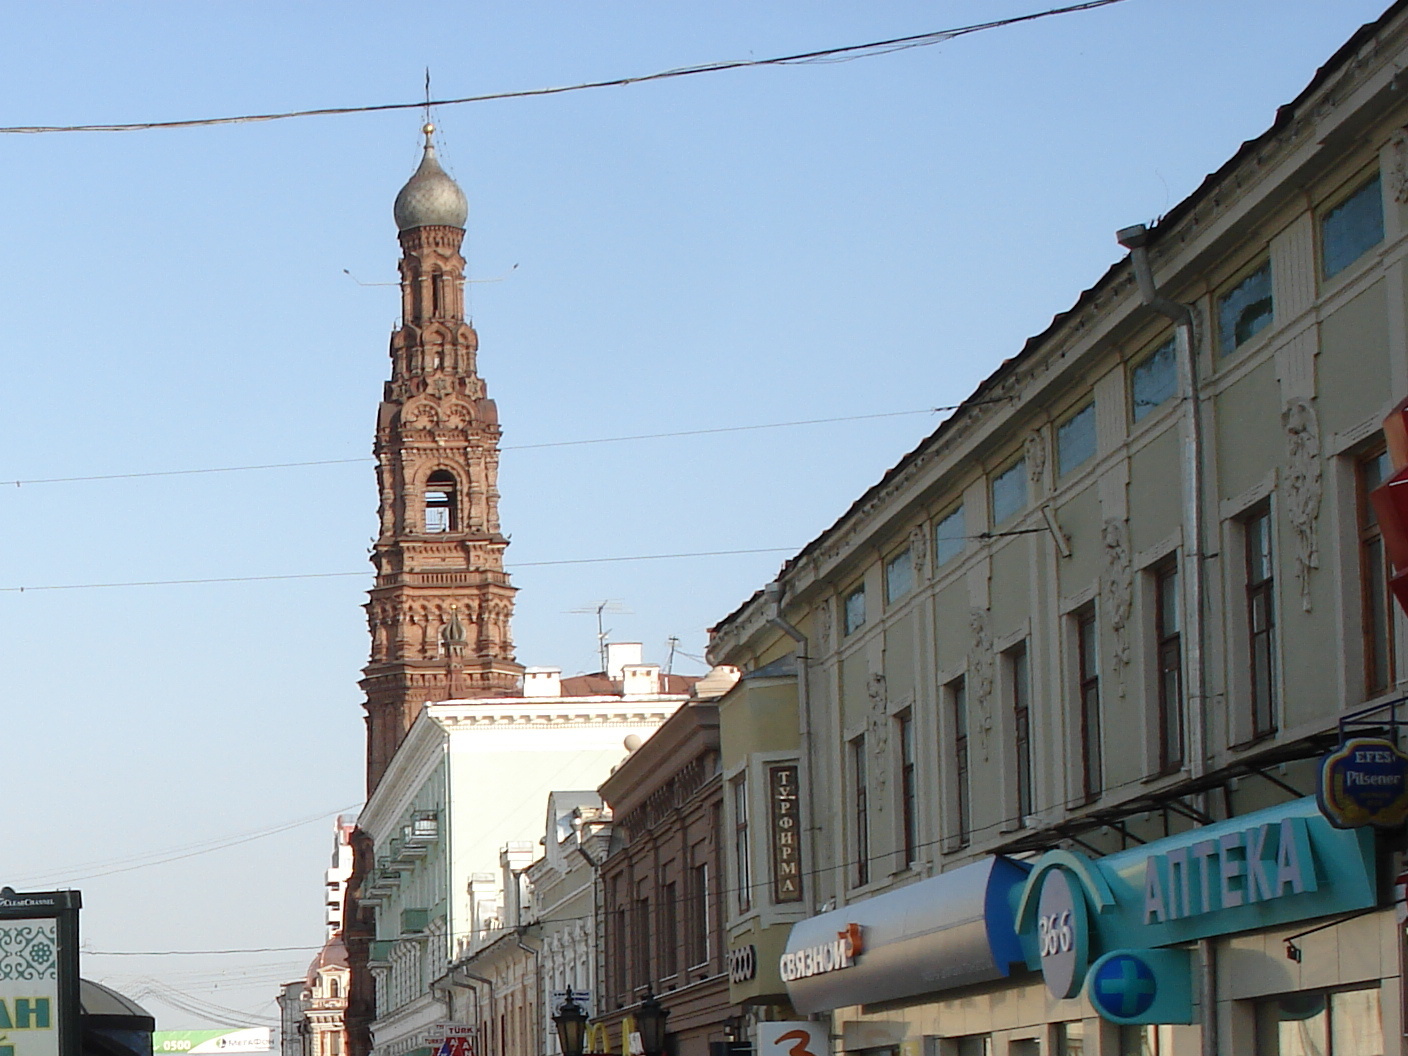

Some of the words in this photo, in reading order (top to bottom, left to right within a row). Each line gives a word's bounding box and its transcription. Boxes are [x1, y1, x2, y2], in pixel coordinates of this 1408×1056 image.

[1346, 770, 1401, 786] Pilsener
[1355, 751, 1391, 763] EFES
[778, 771, 796, 892] ТУРФИРМА
[1144, 817, 1314, 925] АПТЕКА
